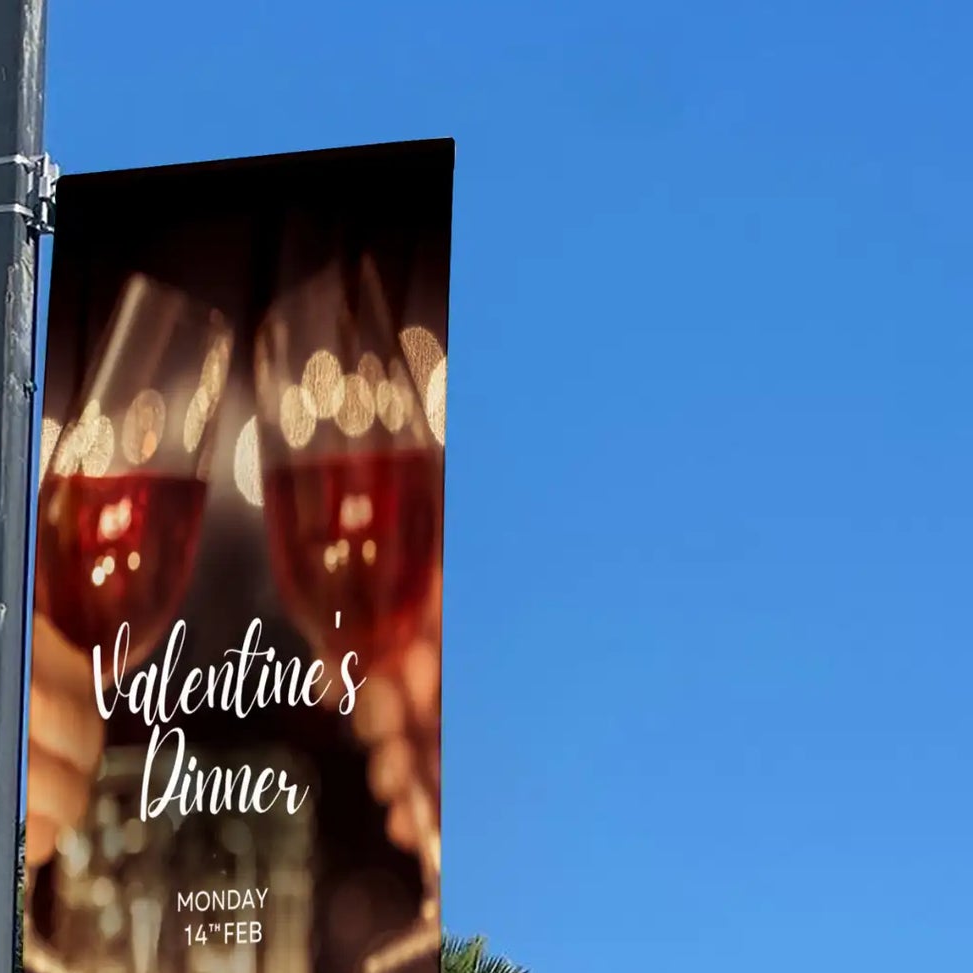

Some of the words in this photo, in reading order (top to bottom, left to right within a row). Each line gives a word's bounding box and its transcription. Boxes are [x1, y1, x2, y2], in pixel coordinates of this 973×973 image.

[92, 611, 367, 726] Valentine's
[140, 723, 310, 823] Dinner
[177, 887, 269, 912] MONDAY
[224, 920, 263, 944] FEB
